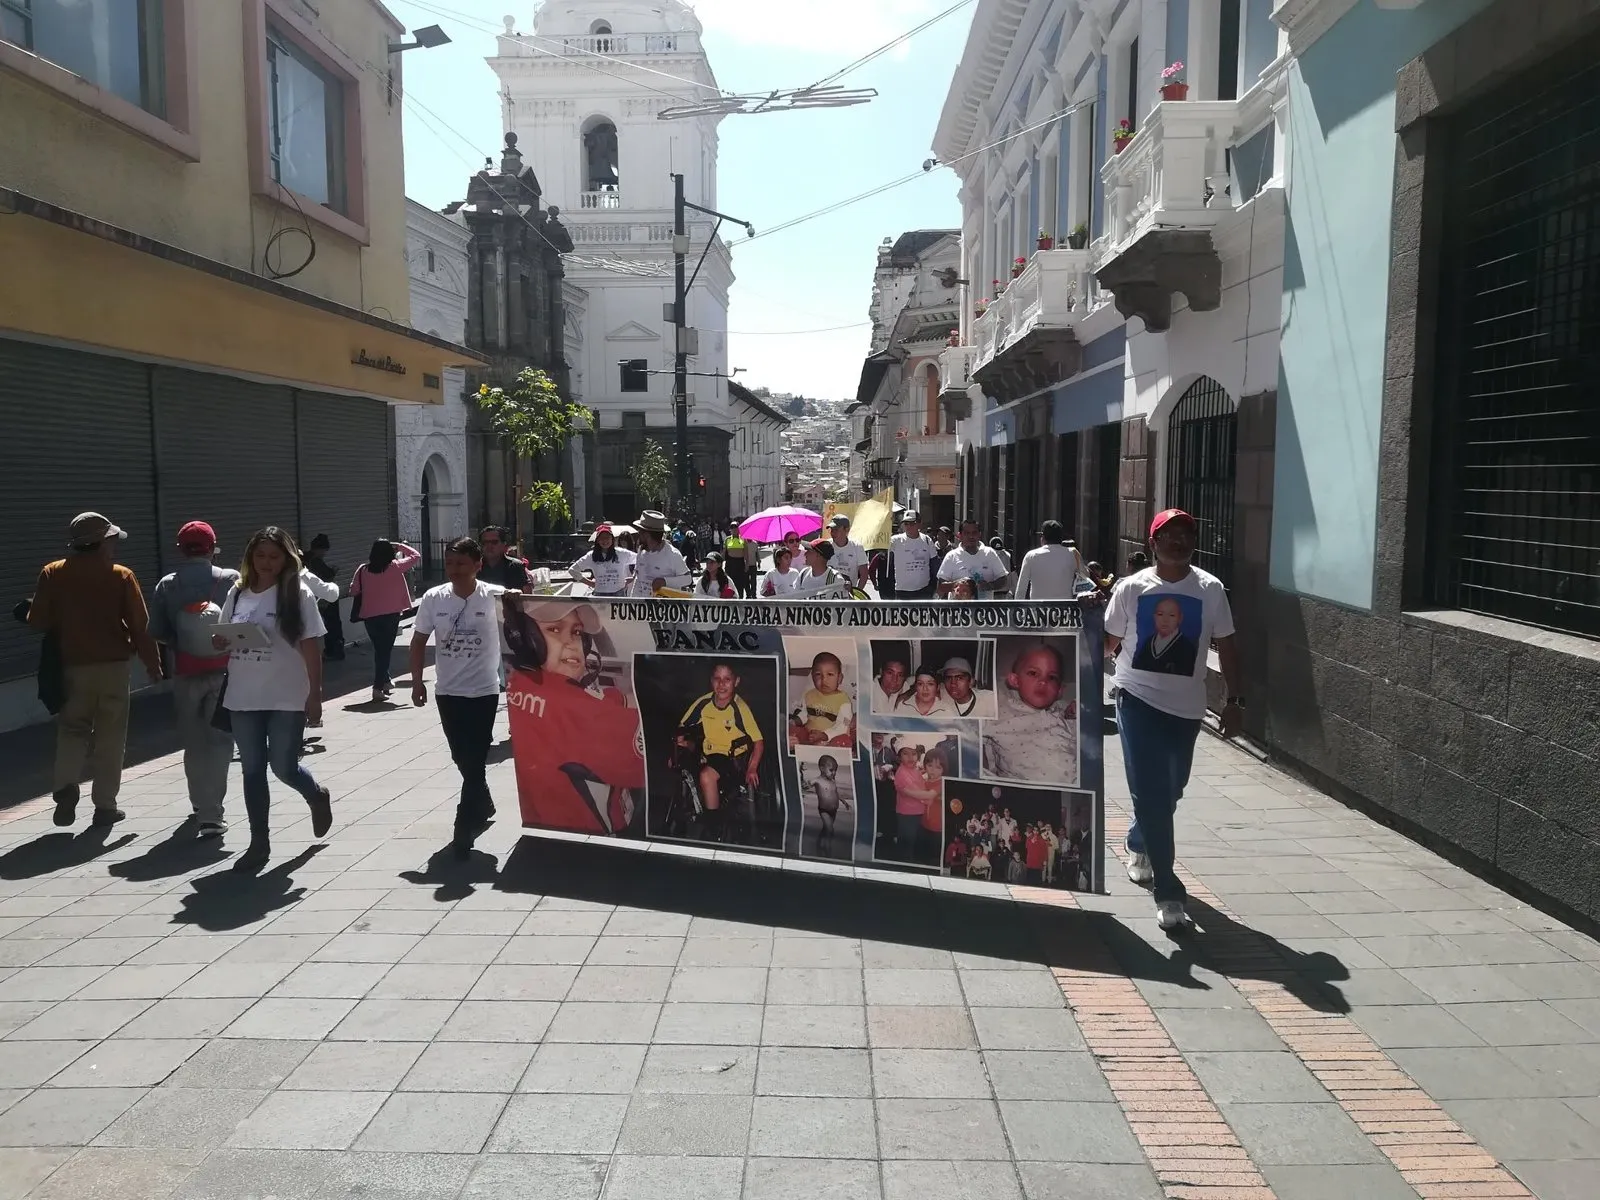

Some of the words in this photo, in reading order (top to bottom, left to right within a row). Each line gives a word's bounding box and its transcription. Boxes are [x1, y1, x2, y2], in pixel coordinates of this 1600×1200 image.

[610, 602, 690, 623] FUNDACION
[691, 605, 742, 625] AYUDA
[743, 605, 784, 626] PARA
[785, 603, 832, 627] NIÑOS
[834, 607, 846, 627] Y
[849, 607, 972, 628] ADOLESCENTES
[974, 607, 1010, 628] CON
[1015, 606, 1083, 628] CANCER
[653, 628, 760, 651] FANAC
